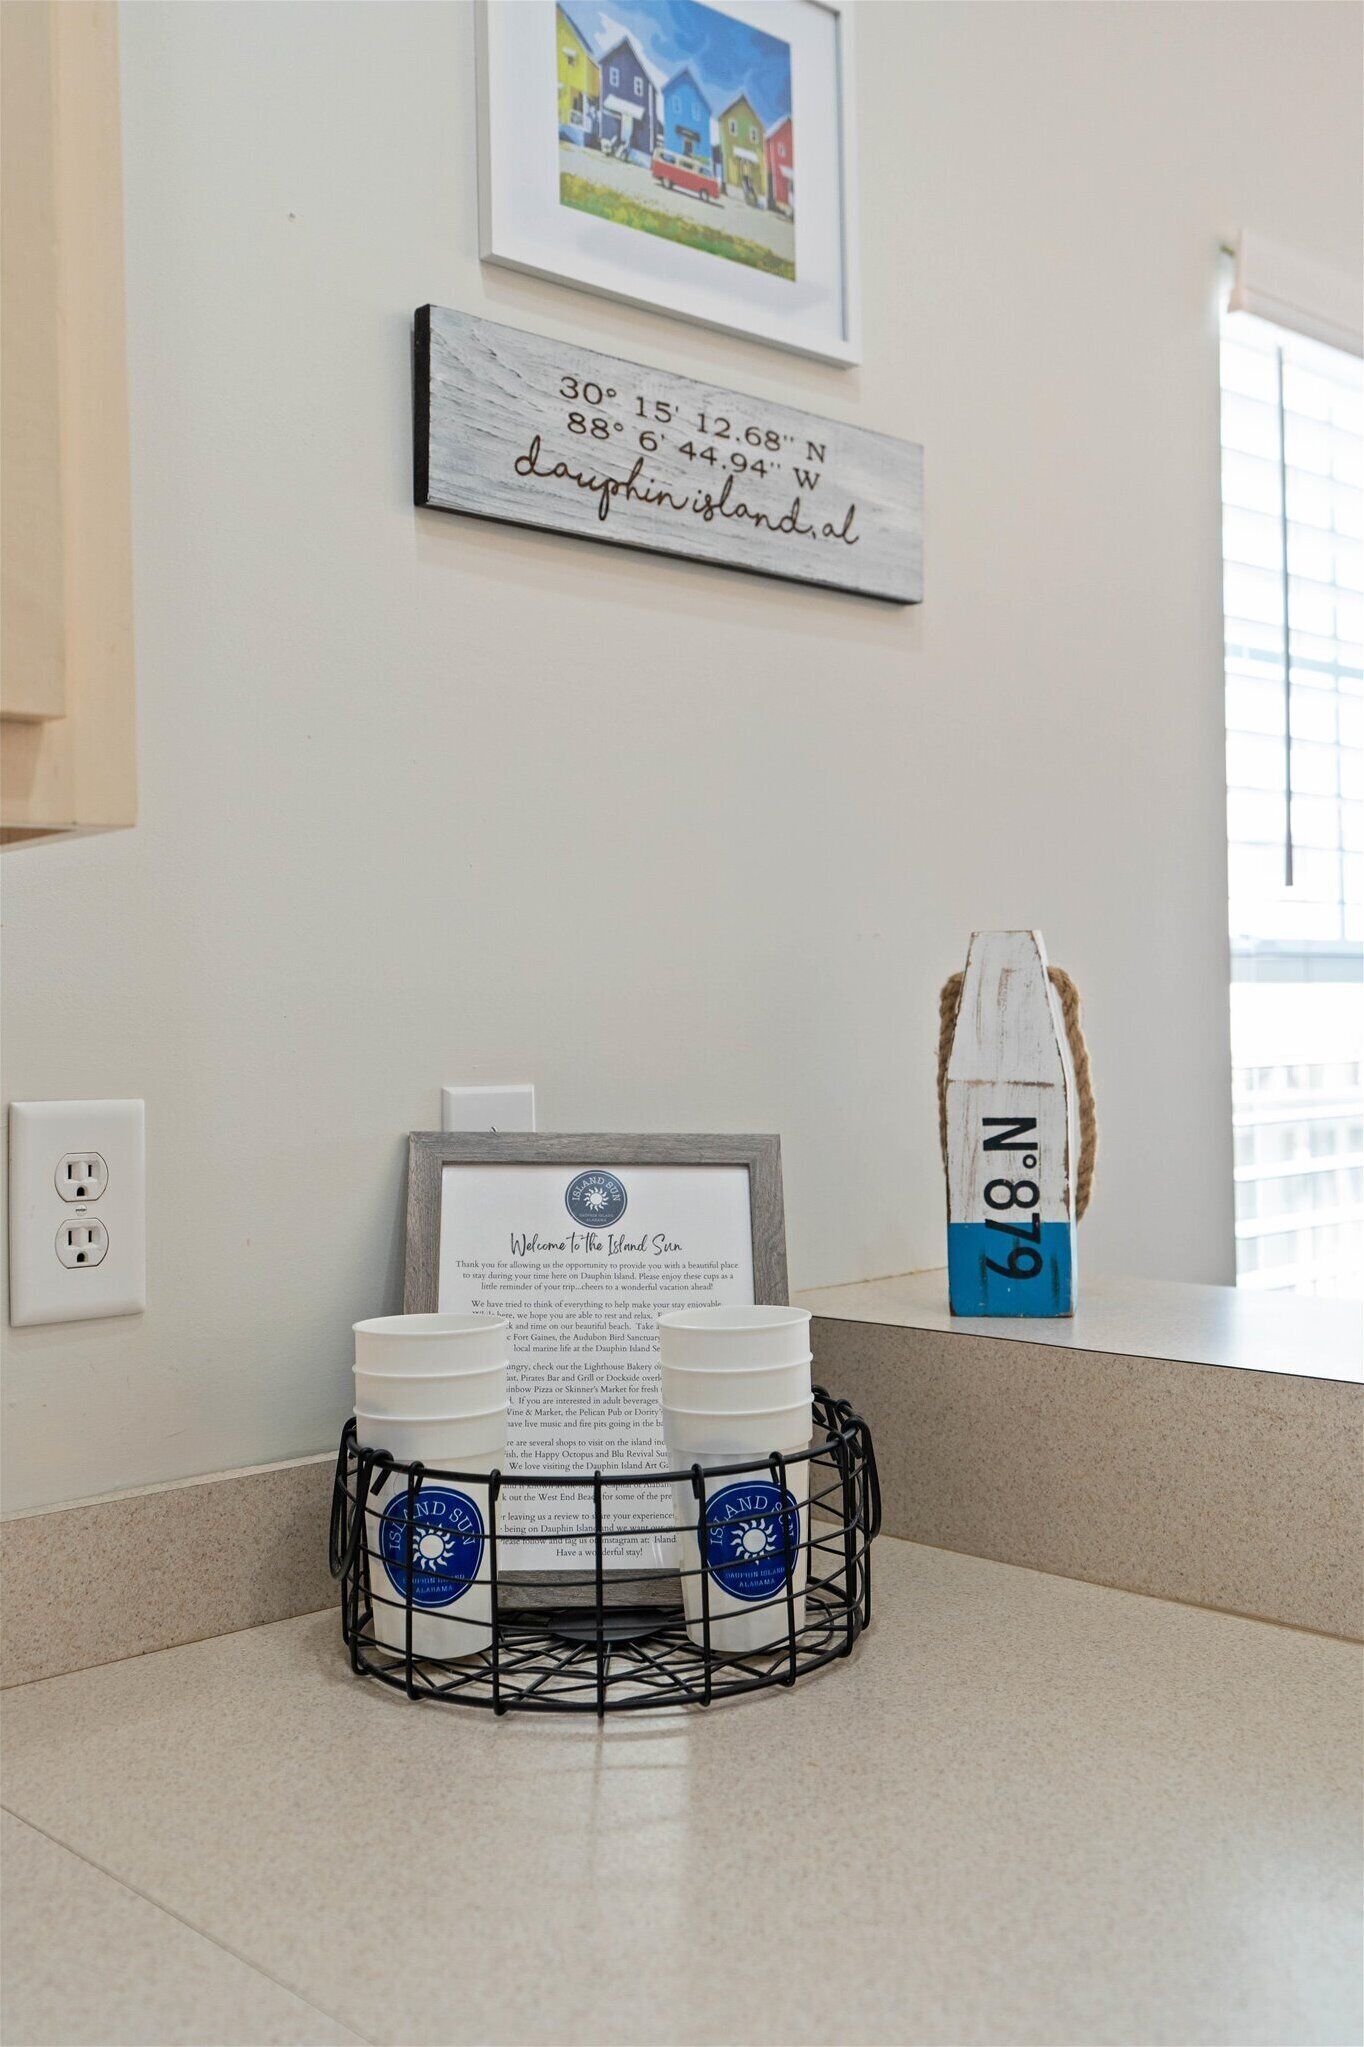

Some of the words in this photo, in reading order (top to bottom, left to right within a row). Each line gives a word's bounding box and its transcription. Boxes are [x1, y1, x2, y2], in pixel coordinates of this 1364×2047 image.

[559, 376, 617, 405] 30°
[635, 396, 679, 423] 15'
[806, 441, 826, 463] N
[567, 412, 624, 440] 88°
[639, 431, 665, 451] 6'
[793, 467, 820, 490] W
[514, 435, 689, 521] dauphin
[822, 504, 859, 544] al
[572, 1175, 605, 1201] ISLAND
[605, 1181, 622, 1201] SUN
[510, 1232, 566, 1257] Welcome
[565, 1232, 583, 1253] to
[580, 1232, 603, 1253] the
[608, 1234, 648, 1256] Island
[652, 1233, 683, 1256] Sun
[456, 1260, 479, 1268] Thank
[481, 1262, 495, 1270] you
[497, 1260, 508, 1268] for
[509, 1260, 541, 1270] allowing
[552, 1260, 564, 1268] the
[566, 1261, 608, 1271] opportunity
[619, 1260, 647, 1271] provide
[648, 1263, 662, 1271] you
[663, 1261, 680, 1269] with
[688, 1261, 718, 1269] beautiful
[472, 1271, 486, 1281] stay
[488, 1271, 513, 1281] during
[515, 1273, 532, 1281] your
[551, 1271, 567, 1279] here
[581, 1271, 612, 1281] Dauphin
[639, 1271, 660, 1279] Please
[661, 1272, 682, 1282] enjoy
[683, 1271, 702, 1280] these
[703, 1274, 719, 1282] cups
[481, 1282, 498, 1290] little
[500, 1282, 532, 1290] reminder
[543, 1284, 561, 1292] your
[621, 1282, 658, 1290] wonderful
[659, 1283, 689, 1291] vacation
[472, 1300, 485, 1308] We
[487, 1300, 503, 1308] have
[505, 1300, 522, 1308] tried
[534, 1300, 553, 1308] think
[564, 1300, 603, 1310] everything
[614, 1300, 630, 1310] help
[632, 1300, 651, 1308] make
[653, 1302, 670, 1310] your
[672, 1301, 685, 1310] stay
[529, 1310, 548, 1321] hope
[549, 1313, 563, 1321] you
[578, 1310, 593, 1319] able
[604, 1311, 617, 1319] rest
[619, 1310, 633, 1319] and
[515, 1322, 529, 1330] and
[530, 1322, 547, 1330] time
[575, 1322, 606, 1330] beautiful
[635, 1322, 654, 1330] Take
[513, 1332, 529, 1341] Fort
[559, 1332, 571, 1341] the
[573, 1332, 607, 1341] Audubon
[609, 1332, 625, 1341] Bird
[513, 1344, 531, 1352] local
[533, 1344, 558, 1352] marine
[560, 1344, 571, 1352] life
[596, 1344, 628, 1354] Dauphin
[629, 1344, 651, 1352] Island
[533, 1362, 554, 1370] check
[584, 1362, 625, 1372] Lighthouse
[627, 1362, 652, 1372] Bakery
[521, 1373, 545, 1381] Pirates
[546, 1373, 560, 1381] Bar
[562, 1373, 576, 1381] and
[577, 1373, 594, 1381] Grill
[605, 1373, 640, 1381] Dockside
[533, 1384, 553, 1393] Pizza
[600, 1384, 627, 1393] Market
[629, 1384, 639, 1393] for
[641, 1384, 658, 1393] fresh
[519, 1396, 525, 1405] If
[526, 1399, 541, 1407] you
[556, 1396, 591, 1405] interested
[603, 1396, 621, 1405] adult
[623, 1396, 659, 1407] beverages
[579, 1408, 605, 1416] Pelican
[608, 1408, 622, 1416] Pub
[525, 1419, 538, 1428] live
[540, 1420, 562, 1428] music
[563, 1419, 577, 1427] and
[579, 1419, 592, 1427] fire
[593, 1420, 607, 1429] pits
[608, 1420, 631, 1429] going
[529, 1438, 554, 1446] several
[556, 1438, 577, 1448] shops
[630, 1438, 653, 1446] island
[535, 1449, 560, 1460] Happy
[561, 1449, 594, 1460] Octopus
[595, 1449, 610, 1458] and
[612, 1449, 625, 1457] Blu
[627, 1449, 654, 1457] Revival
[509, 1461, 523, 1470] We
[525, 1461, 540, 1470] love
[543, 1462, 570, 1472] visiting
[586, 1461, 619, 1471] Dauphin
[621, 1461, 642, 1469] Island
[645, 1461, 657, 1469] Art
[509, 1493, 522, 1501] out
[524, 1492, 537, 1501] the
[538, 1492, 557, 1501] West
[560, 1492, 576, 1500] End
[603, 1492, 613, 1500] for
[646, 1492, 659, 1500] the
[508, 1511, 536, 1522] leaving
[612, 1514, 631, 1522] your
[505, 1524, 527, 1535] being
[541, 1524, 573, 1534] Dauphin
[564, 1537, 578, 1546] tag
[557, 1548, 577, 1556] Have
[584, 1547, 624, 1556] woderful
